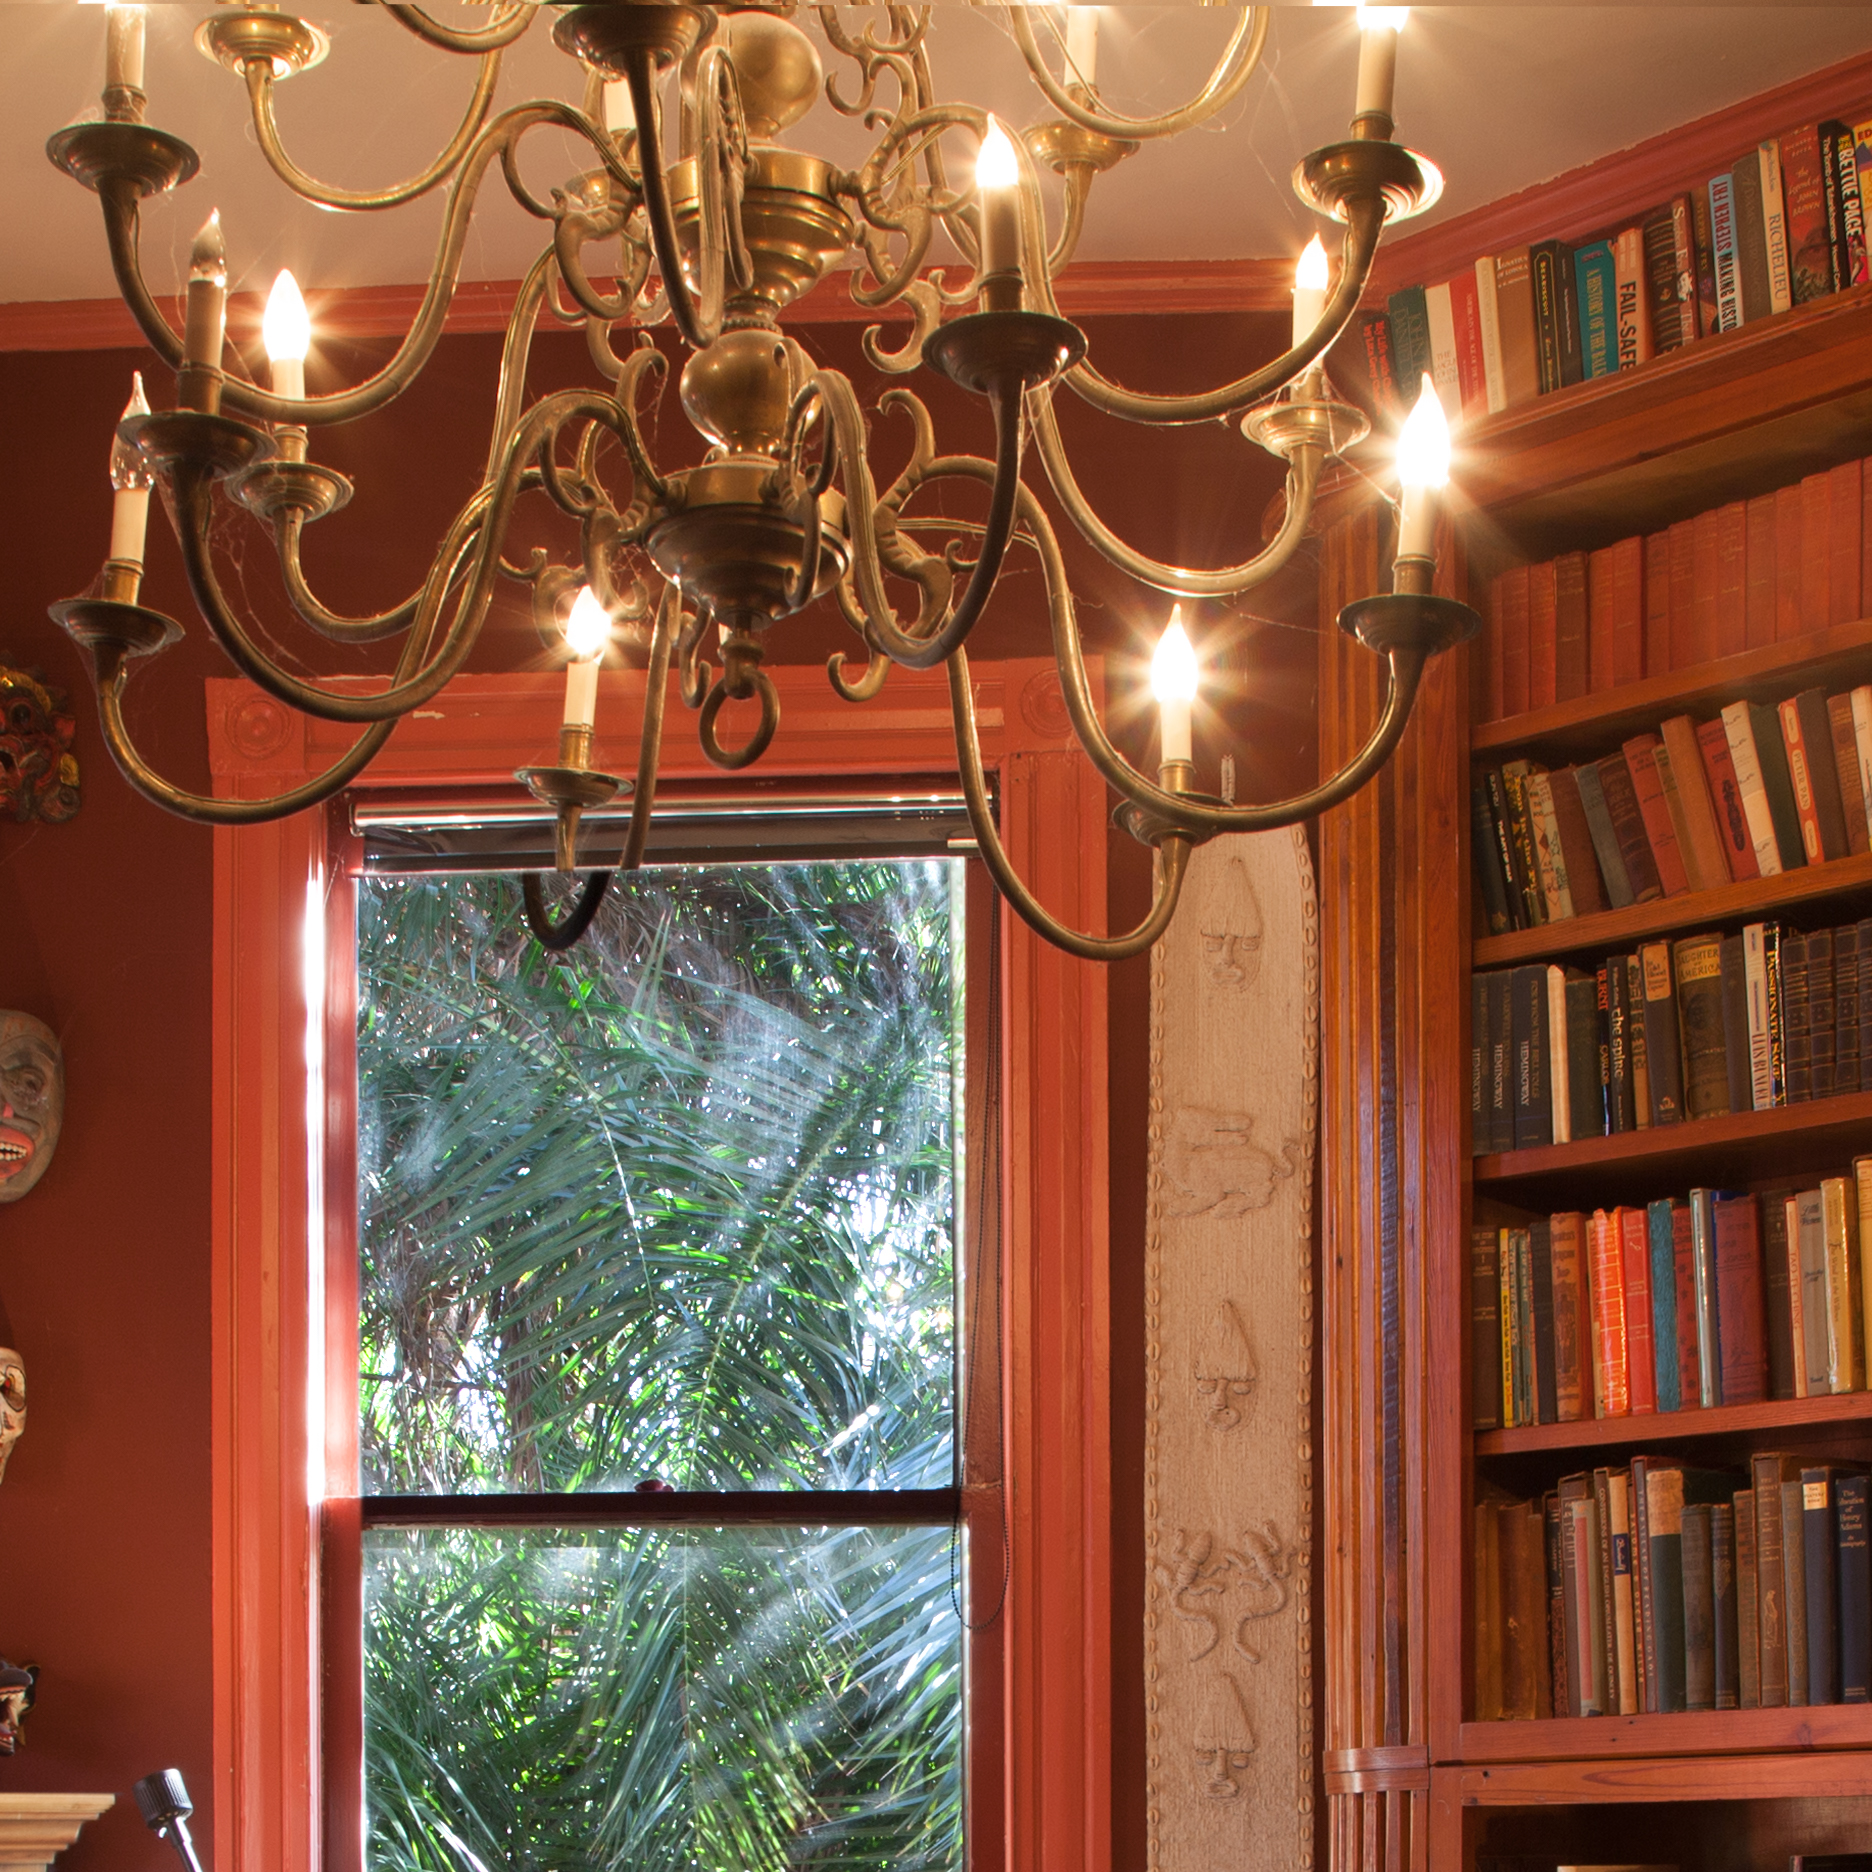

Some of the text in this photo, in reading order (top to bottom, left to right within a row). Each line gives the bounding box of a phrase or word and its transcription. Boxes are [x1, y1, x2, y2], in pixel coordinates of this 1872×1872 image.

[1768, 212, 1789, 301] RICHELIEU
[1793, 752, 1810, 807] PETER PAN
[1611, 1008, 1626, 1079] the spire
